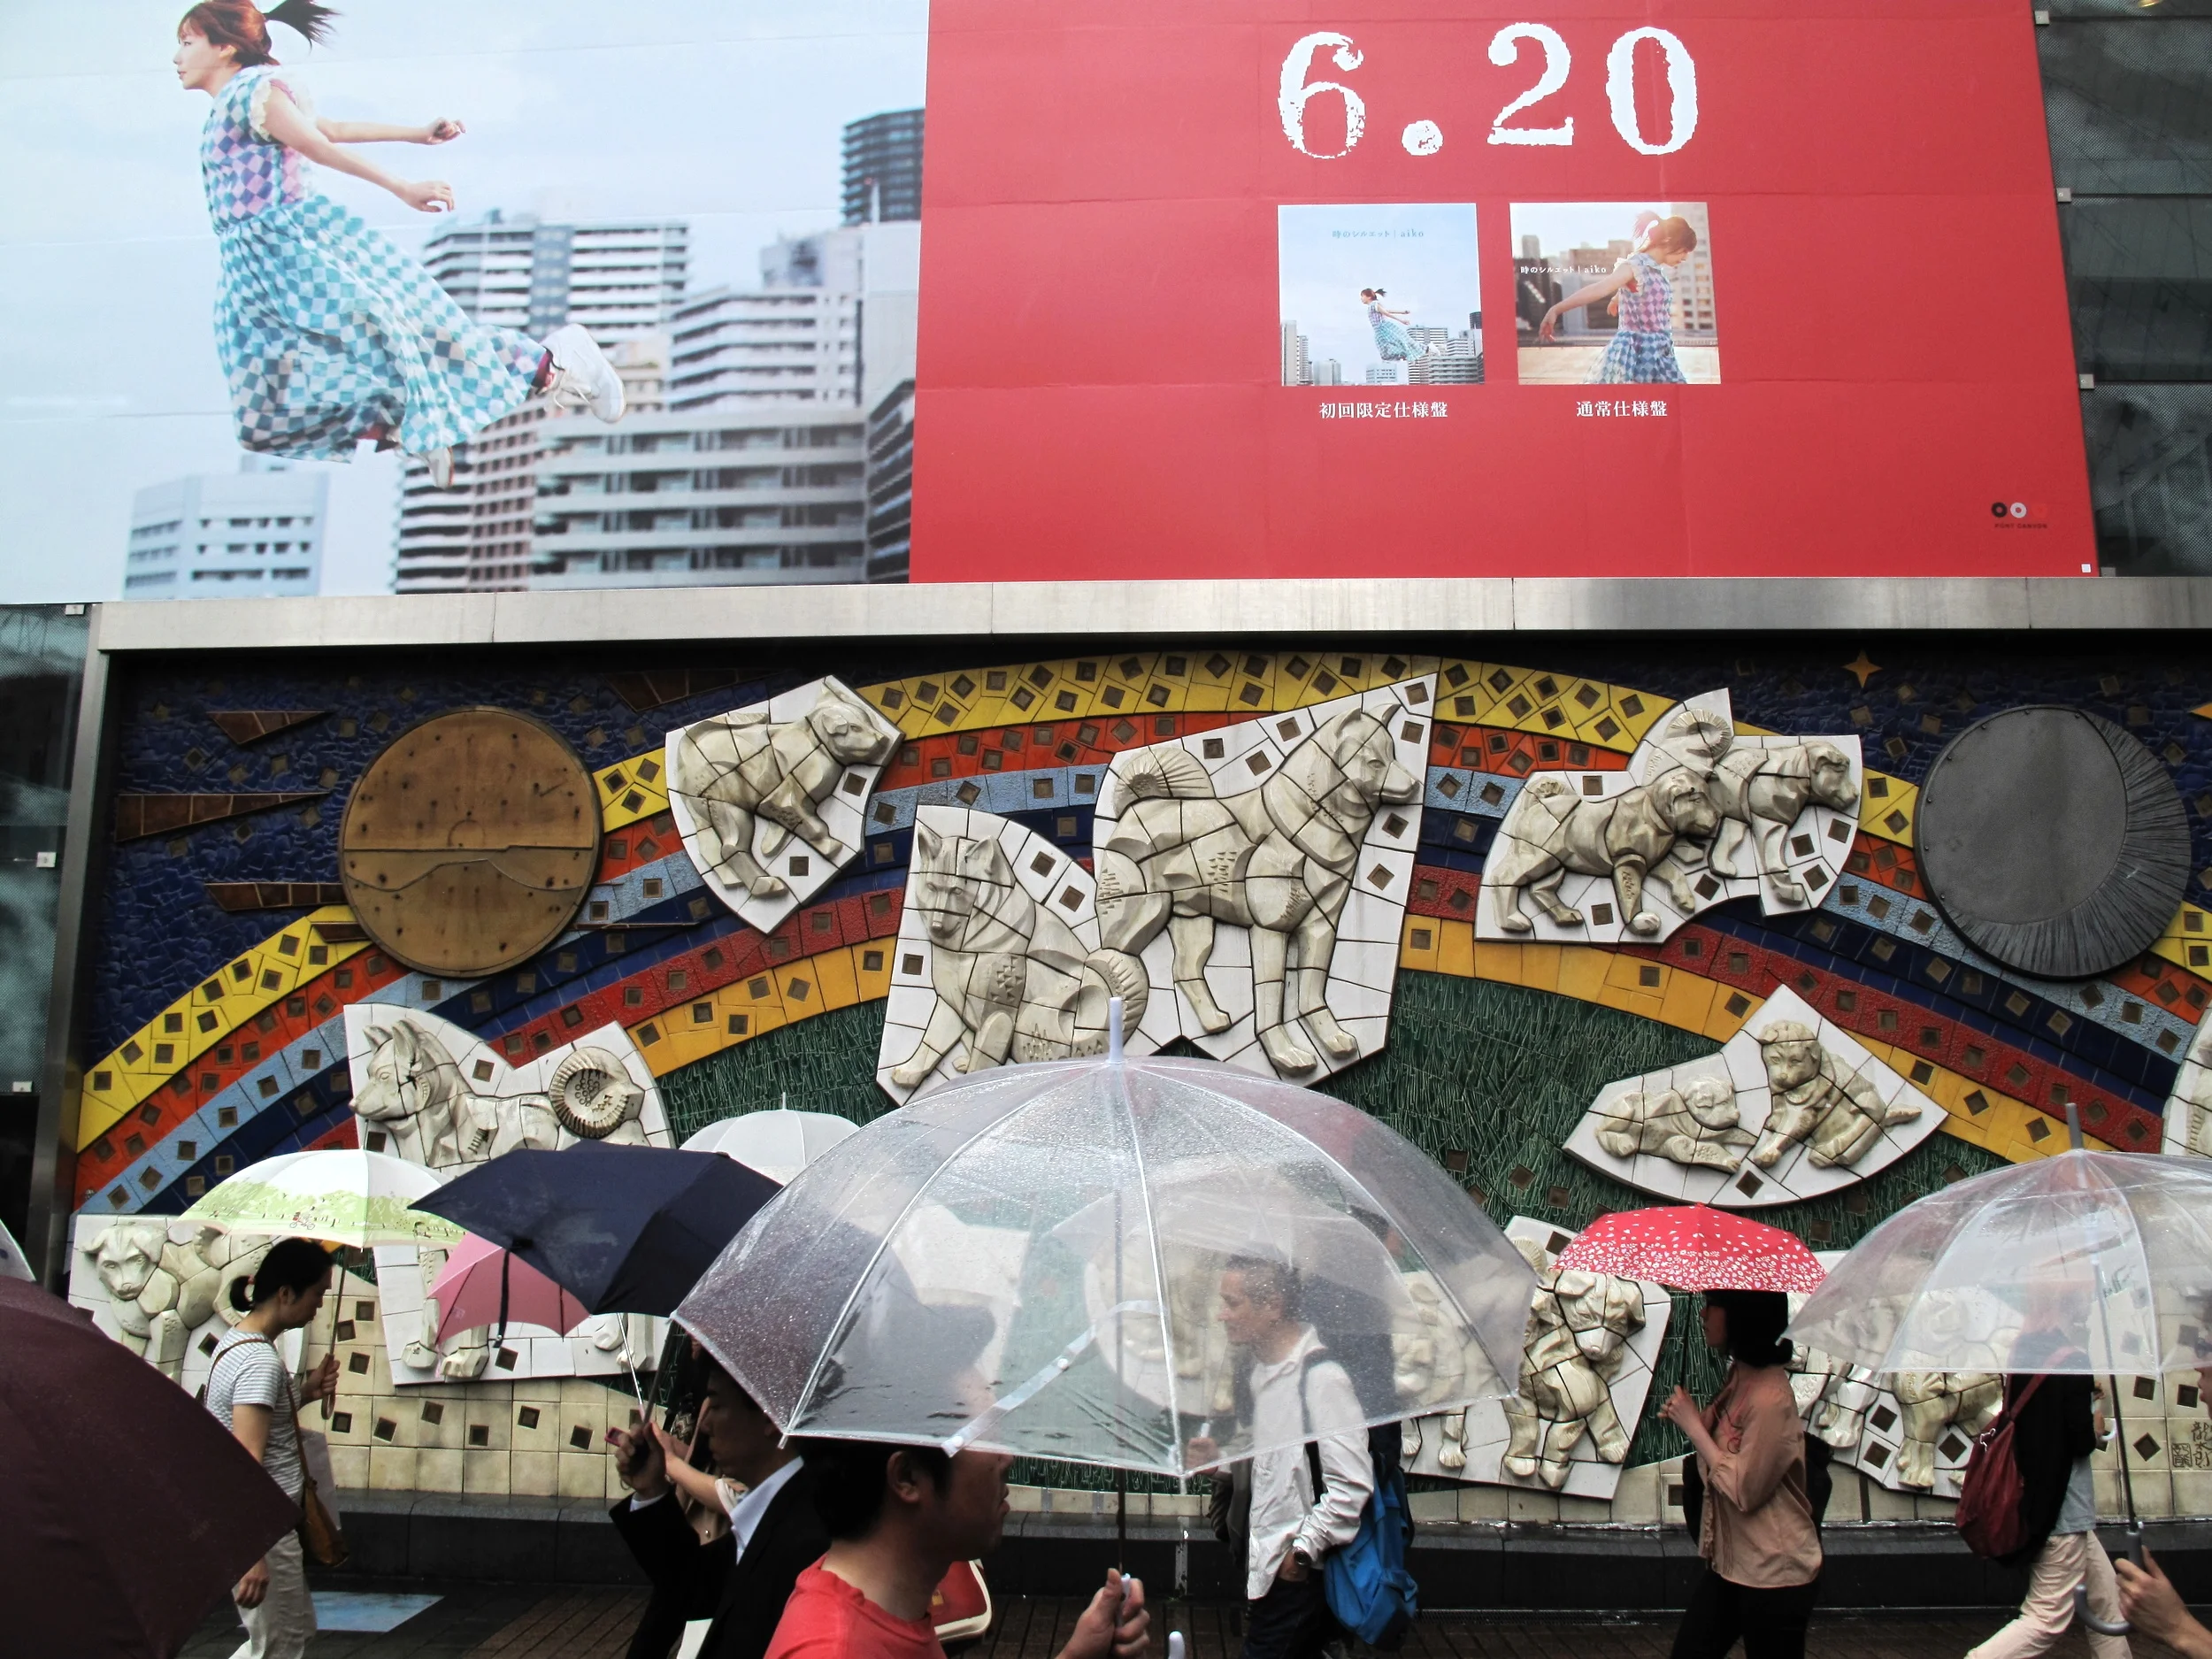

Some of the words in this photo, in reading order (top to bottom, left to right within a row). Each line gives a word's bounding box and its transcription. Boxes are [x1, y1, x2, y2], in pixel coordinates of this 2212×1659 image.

[1278, 21, 1699, 159] 6.20
[1401, 228, 1424, 238] aiko
[1520, 265, 1575, 274] 時のシルエット
[1584, 265, 1607, 273] aiko
[1318, 401, 1448, 419] 初回限定仕様盤
[1576, 400, 1668, 418] 通常仕様盤
